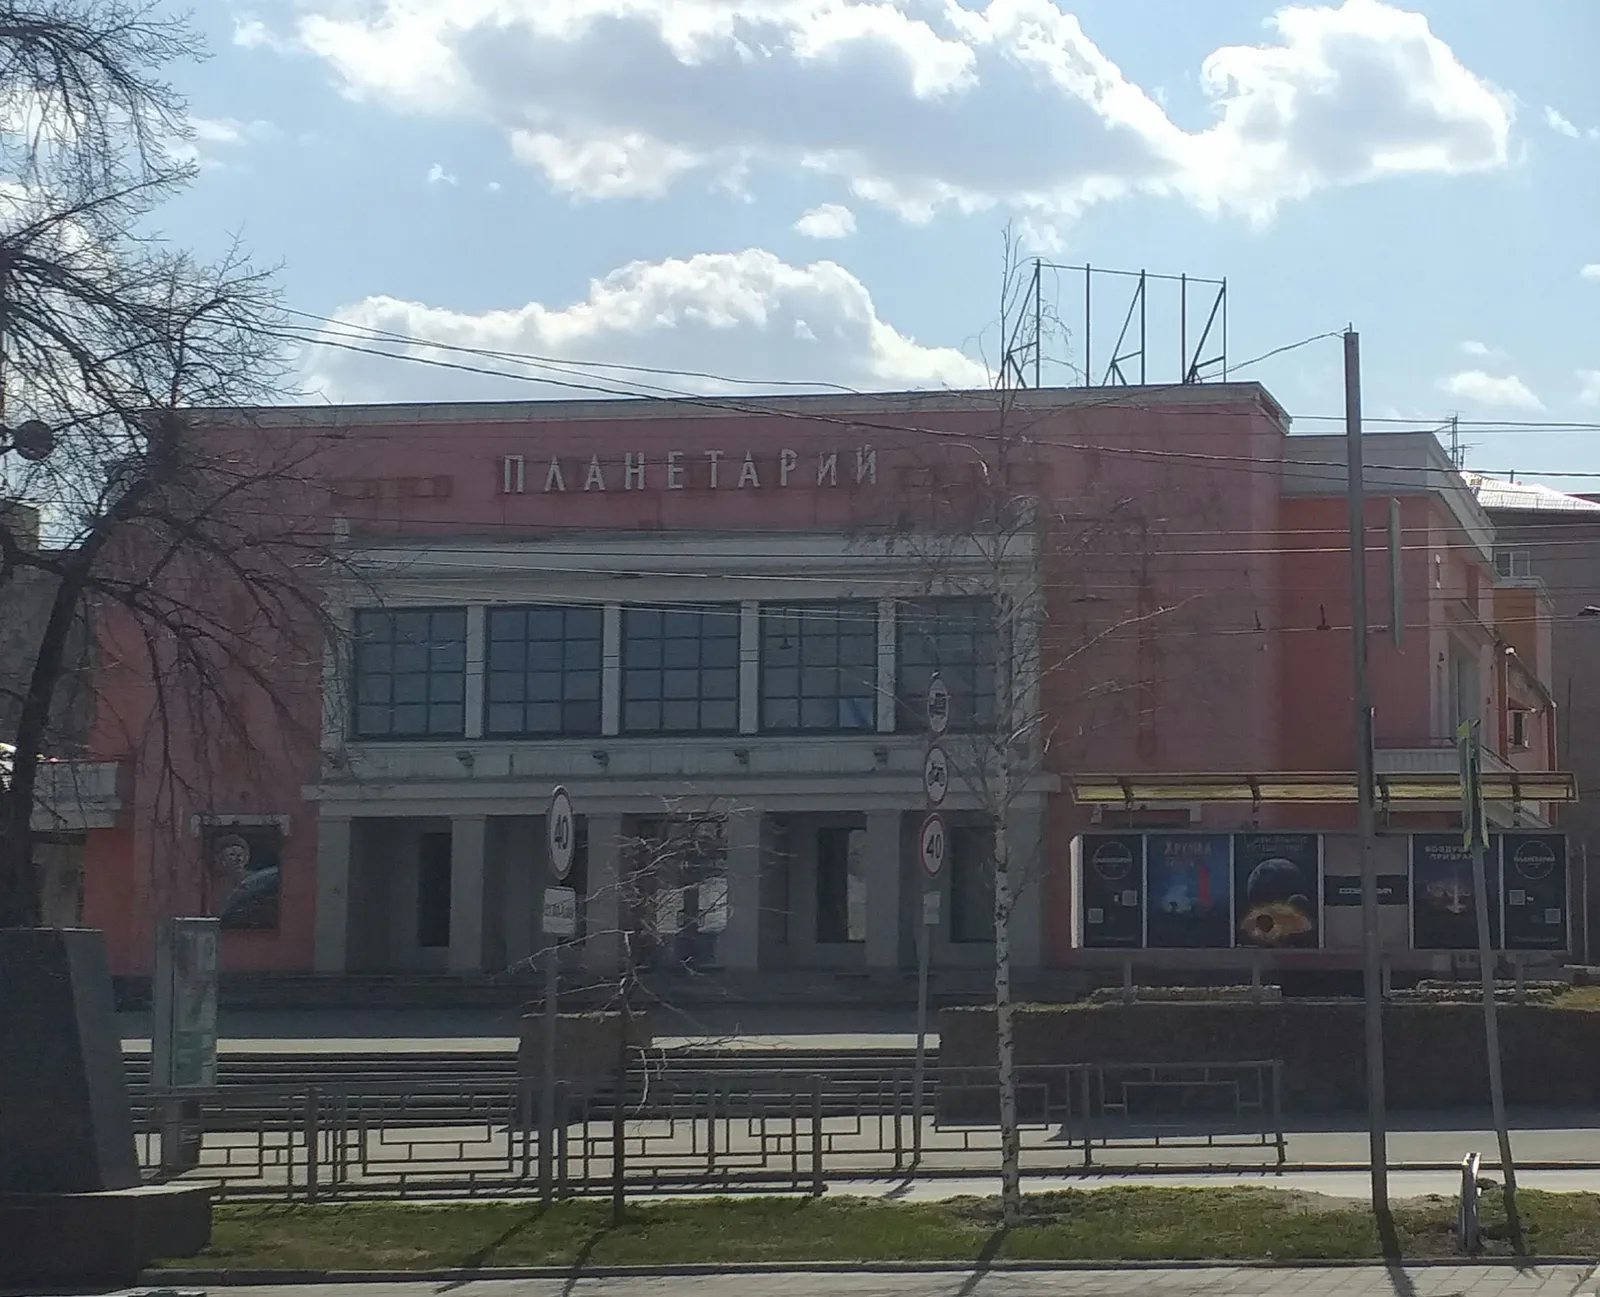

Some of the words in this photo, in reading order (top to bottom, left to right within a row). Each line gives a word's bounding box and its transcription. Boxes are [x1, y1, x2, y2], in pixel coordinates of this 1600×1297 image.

[503, 444, 877, 494] ПЛАНЕТАРИЙ
[555, 815, 568, 849] 40
[926, 834, 941, 859] 40
